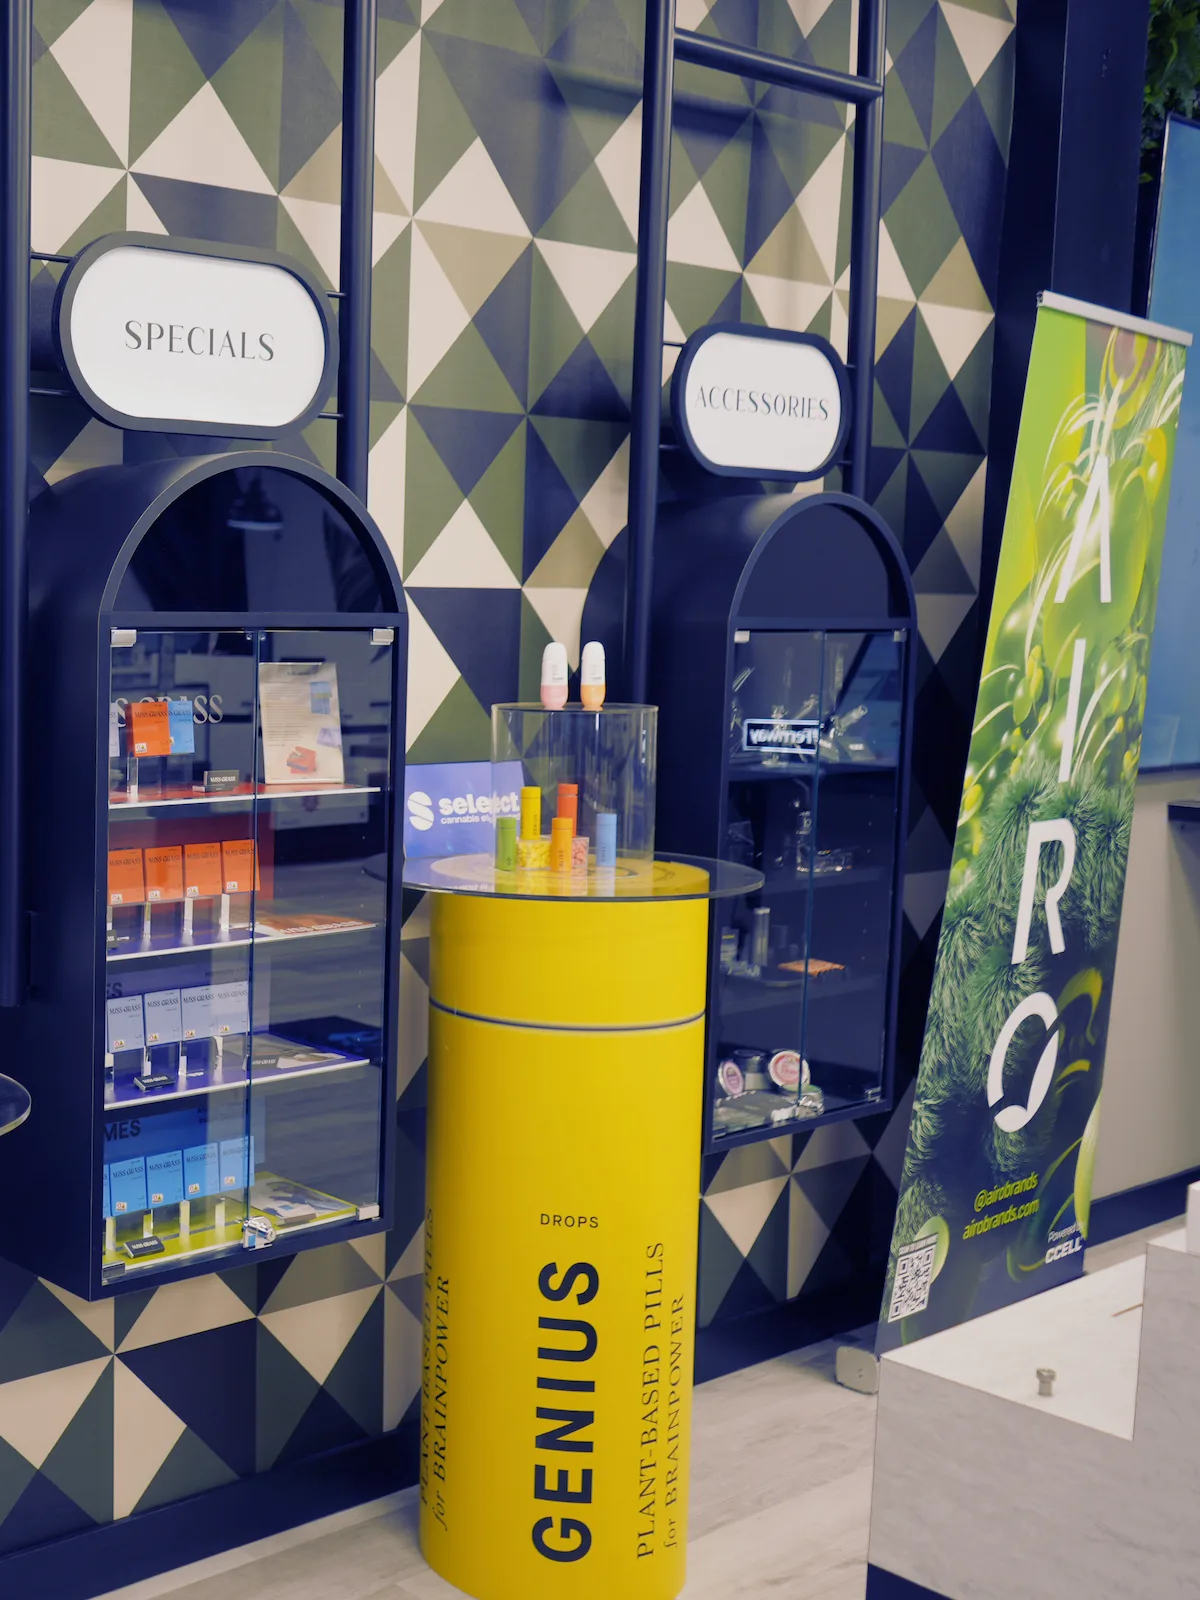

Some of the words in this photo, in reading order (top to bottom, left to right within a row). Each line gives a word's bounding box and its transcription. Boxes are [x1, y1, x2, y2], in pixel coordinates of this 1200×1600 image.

[124, 320, 275, 362] SPECIALS
[694, 384, 829, 422] ACCESSORIES
[438, 791, 520, 816] select
[440, 815, 480, 825] cannabis
[123, 1004, 141, 1013] GRASS
[161, 997, 179, 1007] GRASS
[197, 993, 215, 1003] GRASS
[163, 1159, 181, 1169] GRASS
[973, 1170, 1040, 1213] @airobrands
[540, 1212, 600, 1229] DROPS
[962, 1198, 1040, 1240] airobrands.com
[1047, 1224, 1077, 1243] Powered
[1044, 1237, 1083, 1265] CCELL
[642, 1242, 664, 1332] PILLS
[434, 1275, 450, 1483] BRAINPOWER
[531, 1261, 600, 1563] GENIUS
[664, 1294, 685, 1509] BRAINPOWER
[636, 1343, 662, 1560] PLANT-BASED
[432, 1489, 448, 1532] for
[663, 1516, 678, 1548] for
